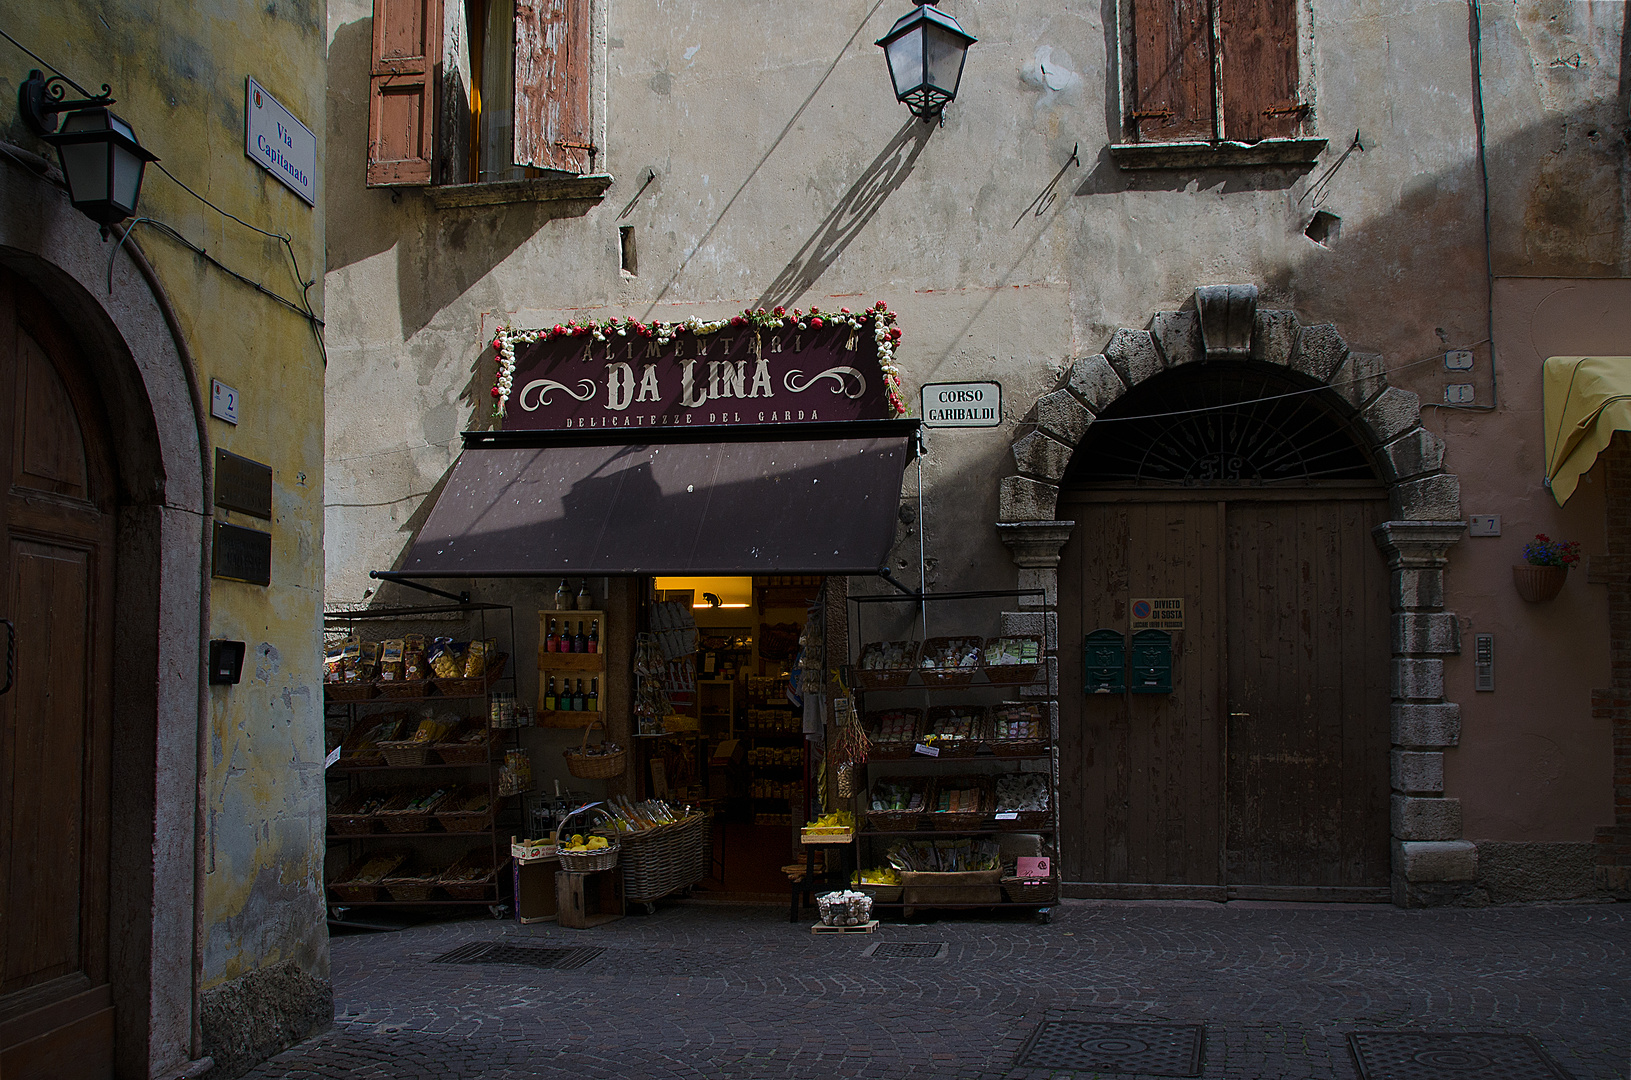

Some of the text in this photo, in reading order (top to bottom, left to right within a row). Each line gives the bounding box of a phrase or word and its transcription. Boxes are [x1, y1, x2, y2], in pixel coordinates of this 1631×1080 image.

[277, 121, 292, 148] Via
[257, 134, 308, 187] Capitanato
[582, 334, 802, 362] ALIMENTARI
[603, 358, 775, 411] DA LINA
[227, 393, 234, 411] 2
[938, 389, 983, 403] CORSO
[566, 409, 819, 428] DELICATEZZE DEL GARDA
[929, 407, 995, 421] GARIBALDI
[1487, 519, 1495, 530] 7
[1154, 600, 1180, 609] DIVIETO
[1152, 610, 1183, 619] DI SOSTA
